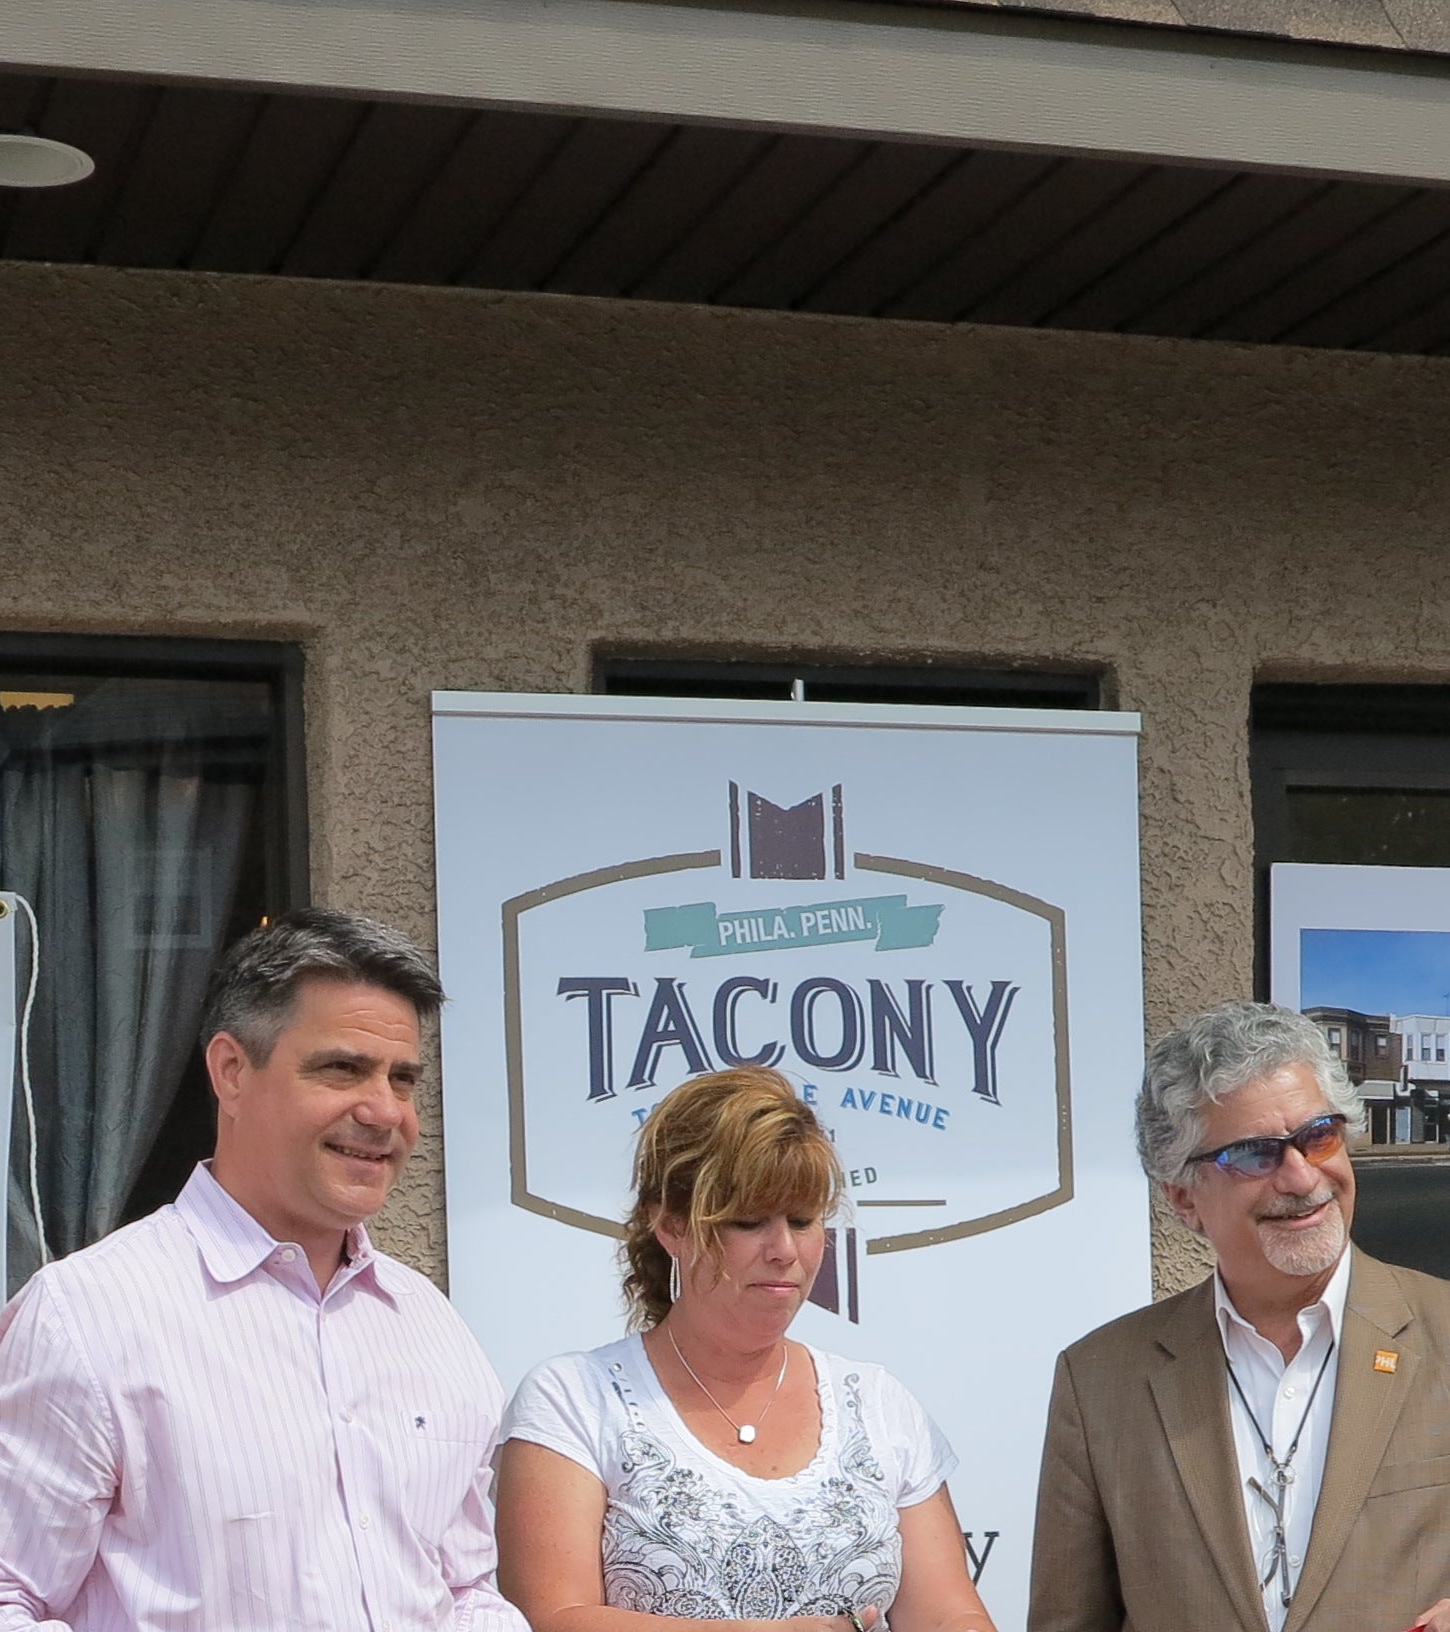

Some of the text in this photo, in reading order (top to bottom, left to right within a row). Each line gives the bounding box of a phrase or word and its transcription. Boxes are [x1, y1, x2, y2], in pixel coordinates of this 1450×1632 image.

[718, 906, 872, 946] PHILA. PENN.
[556, 975, 1022, 1106] TACONY
[840, 1087, 950, 1131] AVENUE
